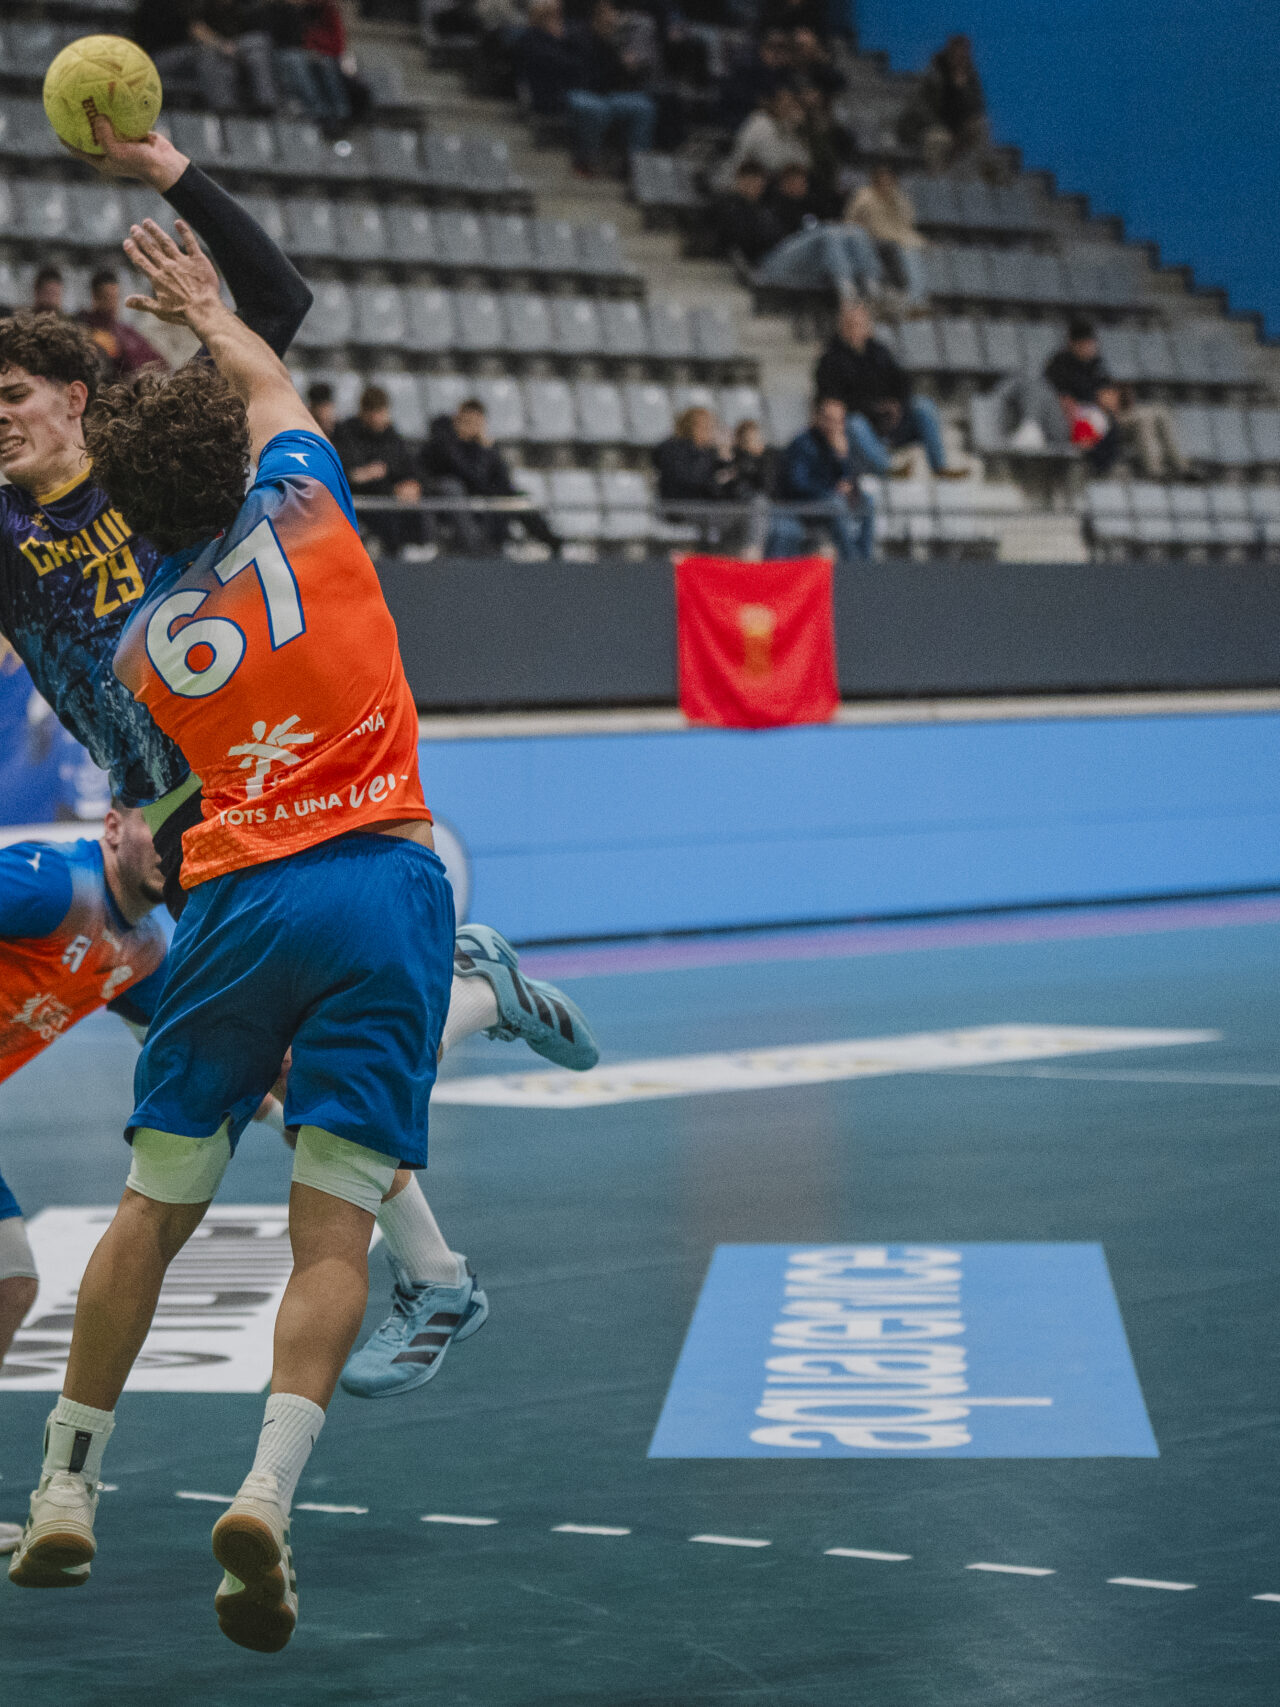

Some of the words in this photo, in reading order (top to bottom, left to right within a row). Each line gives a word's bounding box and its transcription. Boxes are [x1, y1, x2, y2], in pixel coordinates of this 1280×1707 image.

[82, 544, 145, 619] 29
[146, 515, 307, 698] 67
[219, 808, 268, 826] TOTS
[273, 804, 290, 821] A
[293, 793, 344, 817] UNA
[749, 1246, 1053, 1450] aquaservice
